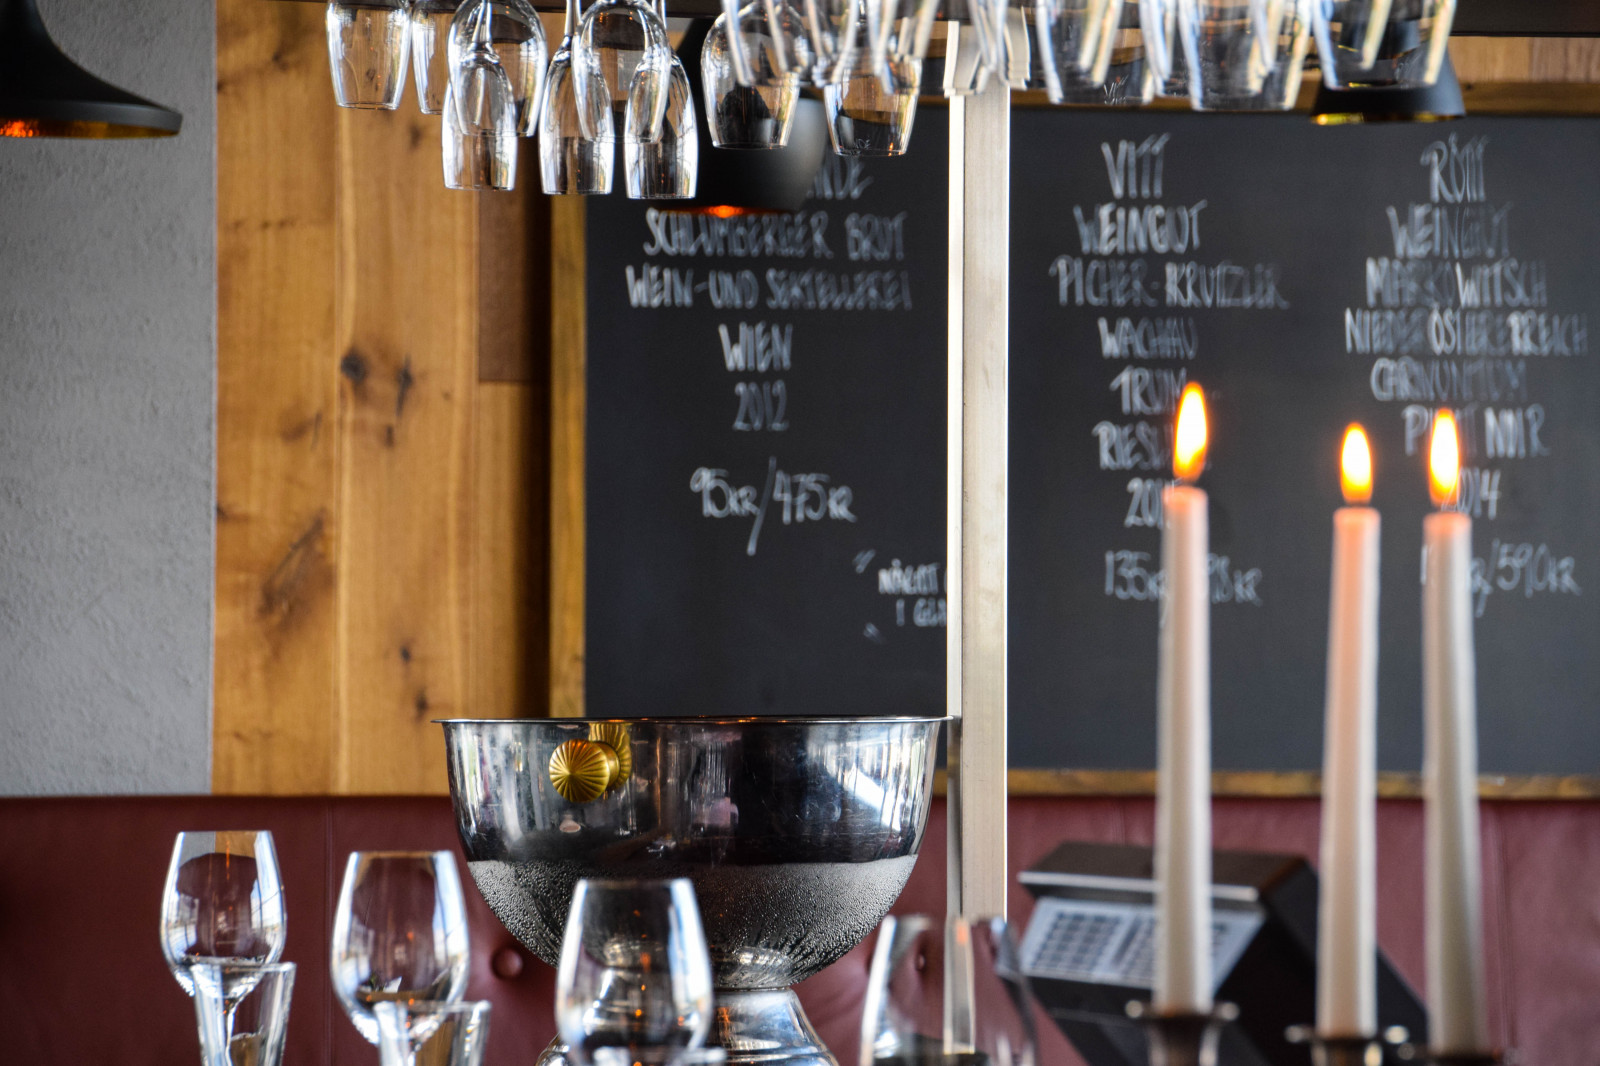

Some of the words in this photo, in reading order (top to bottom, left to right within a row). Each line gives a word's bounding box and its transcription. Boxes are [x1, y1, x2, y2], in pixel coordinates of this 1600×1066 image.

[1073, 199, 1209, 256] WEINGUT
[718, 320, 793, 373] WIEN
[732, 379, 790, 432] 2012
